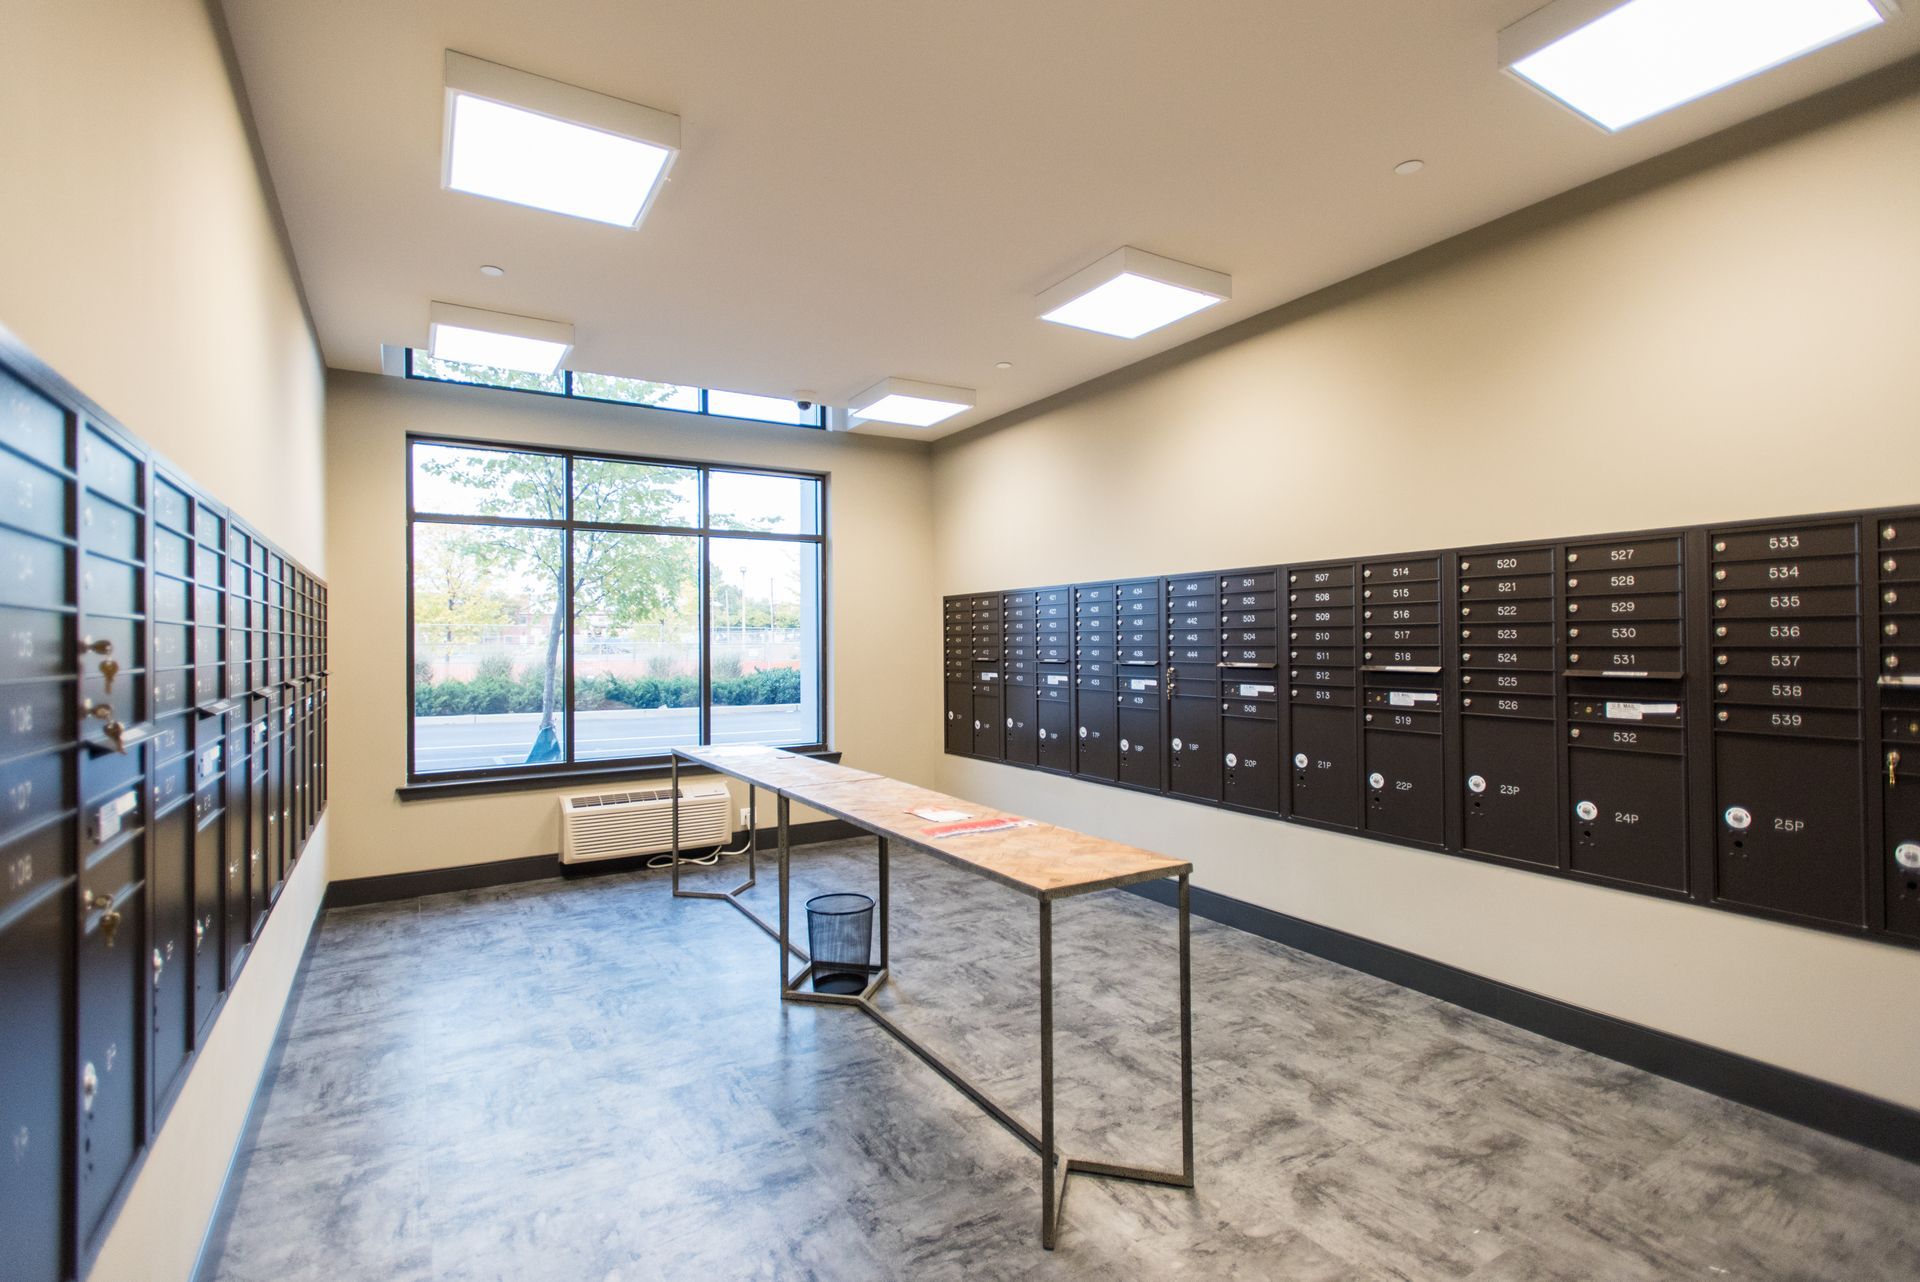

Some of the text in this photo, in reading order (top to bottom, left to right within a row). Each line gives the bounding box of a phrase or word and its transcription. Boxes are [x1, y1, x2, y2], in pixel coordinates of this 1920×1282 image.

[1768, 535, 1800, 550] 533
[1610, 548, 1635, 561] 527
[1496, 558, 1518, 569] 520
[1392, 567, 1410, 577] 514
[1768, 565, 1800, 579] 534
[1242, 578, 1255, 587] 501
[1314, 573, 1330, 583] 507
[1610, 575, 1635, 587] 528
[1131, 587, 1144, 596] 434
[1185, 583, 1198, 592] 440
[1498, 582, 1517, 593] 521
[1314, 592, 1330, 602] 508
[1392, 588, 1410, 598] 515
[1185, 600, 1198, 608] 441
[1242, 596, 1256, 605] 502
[1769, 595, 1801, 608] 535
[1132, 603, 1143, 611] 435
[1497, 605, 1518, 616] 522
[1610, 601, 1636, 613] 529
[1242, 614, 1256, 623] 503
[1315, 612, 1331, 622] 509
[1393, 609, 1410, 620] 516
[1132, 618, 1144, 627] 436
[1186, 617, 1198, 625] 442
[1242, 632, 1257, 641] 504
[1315, 632, 1330, 641] 510
[1393, 630, 1411, 640] 517
[1497, 629, 1518, 639] 523
[1611, 627, 1637, 639] 530
[1769, 625, 1801, 638] 536
[1132, 634, 1144, 642] 437
[1186, 633, 1199, 642] 443
[1132, 649, 1144, 658] 438
[1186, 650, 1199, 658] 444
[1242, 650, 1257, 659] 505
[1316, 651, 1330, 661] 511
[1394, 652, 1412, 661] 518
[1497, 652, 1518, 663] 524
[1613, 654, 1635, 665] 531
[1770, 655, 1801, 667] 537
[1315, 671, 1331, 680] 512
[1497, 676, 1518, 687] 525
[1315, 690, 1331, 700] 513
[1771, 684, 1802, 697] 538
[1133, 696, 1144, 705] 439
[1498, 699, 1519, 711] 526
[1243, 704, 1257, 713] 506
[1394, 715, 1412, 726] 519
[1771, 713, 1802, 727] 539
[1613, 731, 1638, 743] 532
[1188, 743, 1200, 751] 19P
[1244, 759, 1257, 768] 20P
[1317, 760, 1332, 769] 21P
[1395, 780, 1413, 791] 22P
[1500, 784, 1520, 795] 23P
[1614, 811, 1639, 824] 24P
[1774, 818, 1805, 832] 25P
